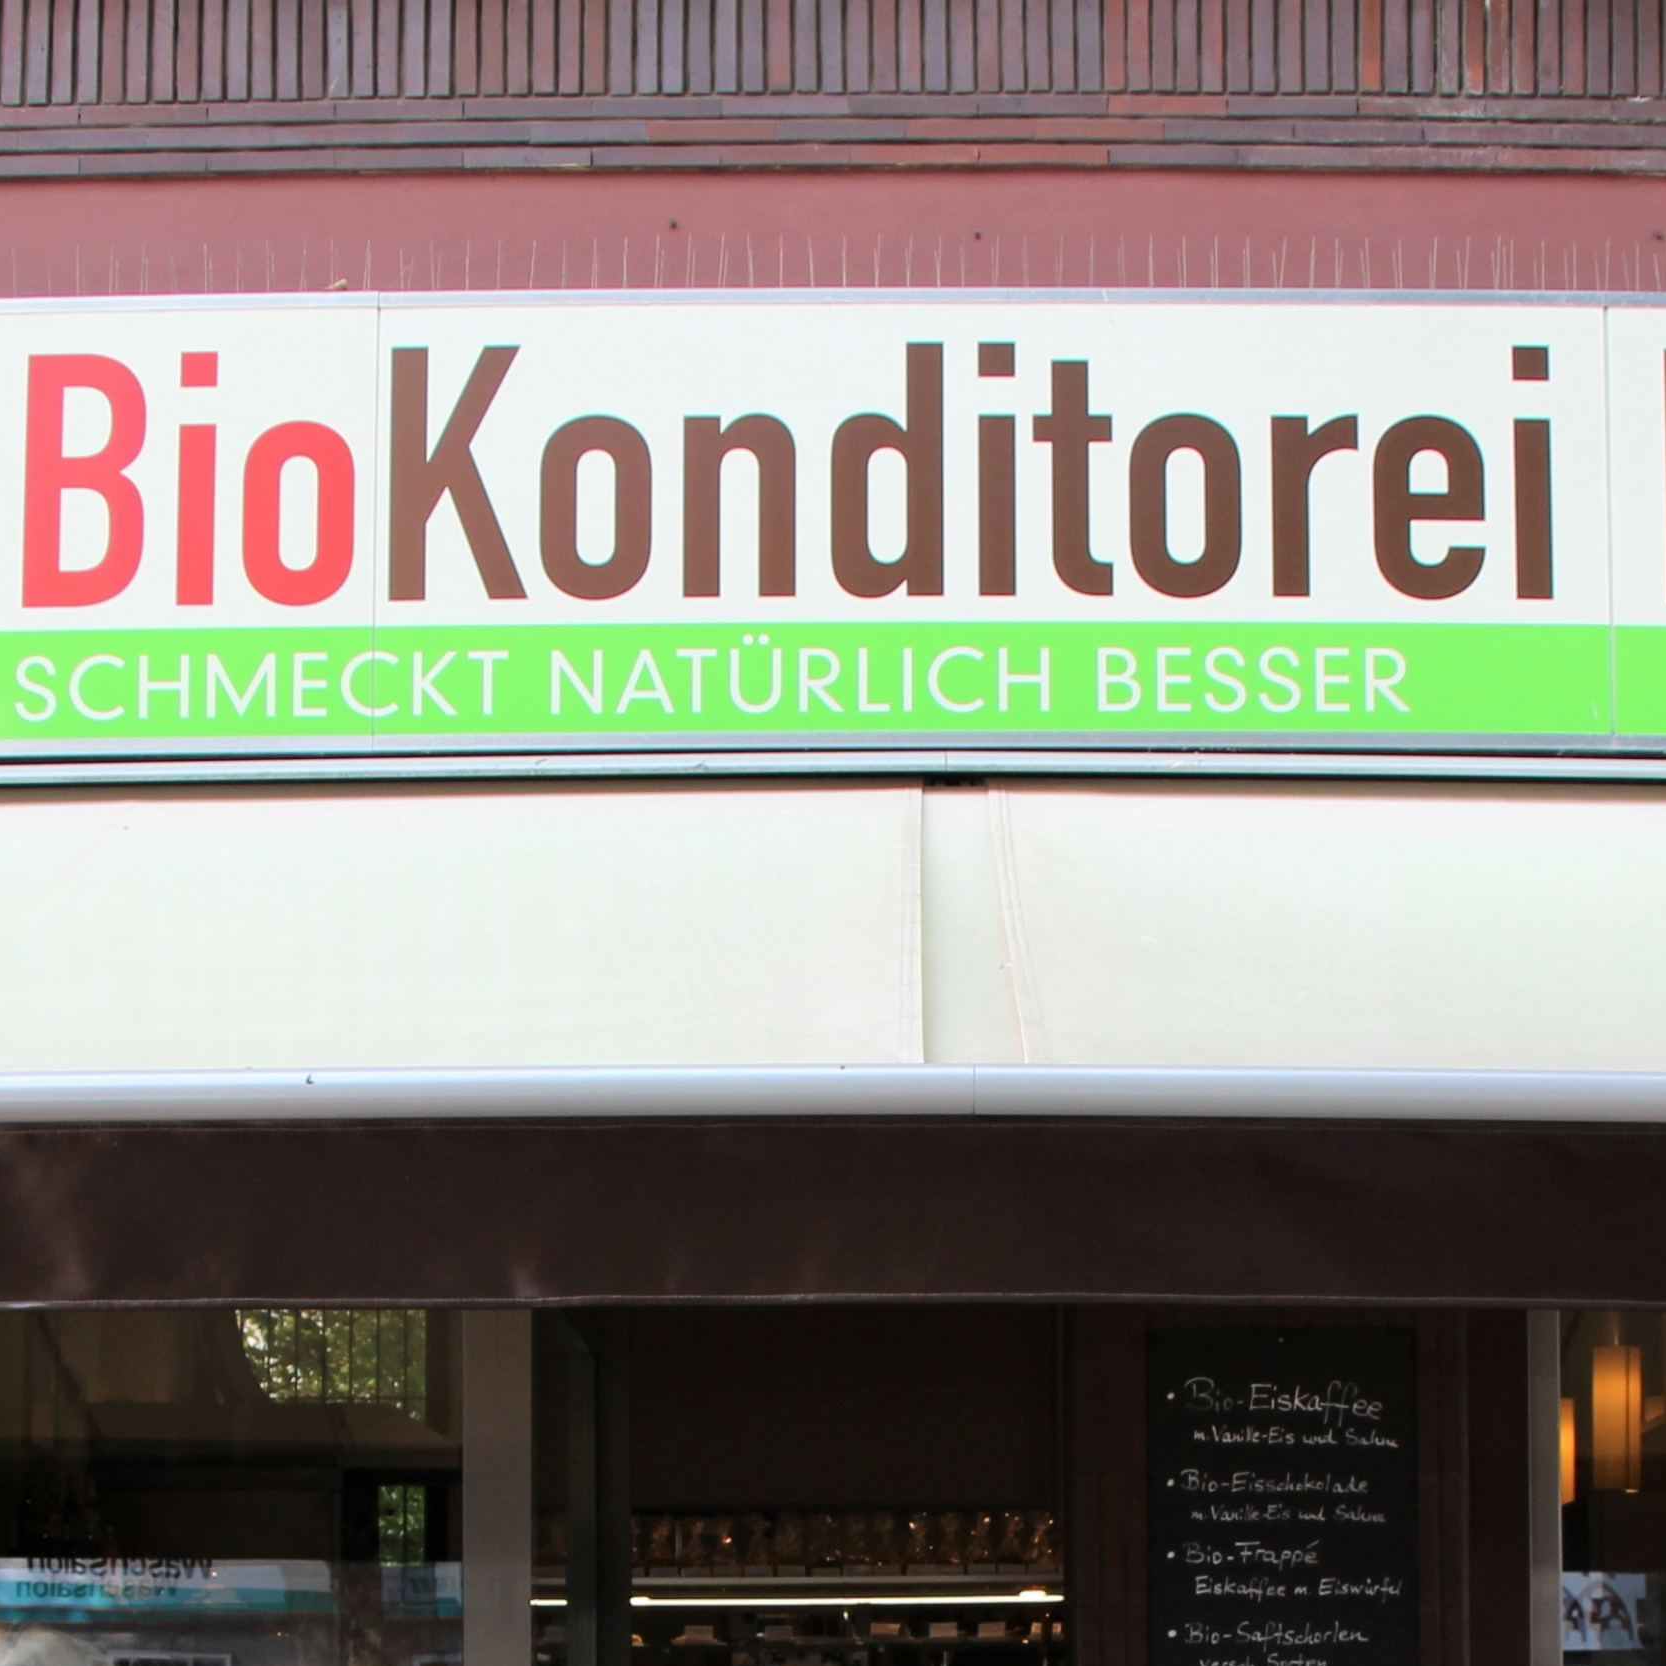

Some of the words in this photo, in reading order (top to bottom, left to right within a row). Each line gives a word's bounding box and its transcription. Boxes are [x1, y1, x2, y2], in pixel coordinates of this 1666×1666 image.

[20, 341, 1555, 611] BioKonditorei
[14, 646, 509, 723] SCHMECKT
[549, 632, 1053, 716] NATÜRLICH
[1097, 646, 1412, 716] BESSER
[1194, 1575, 1286, 1603] Eiskaffee
